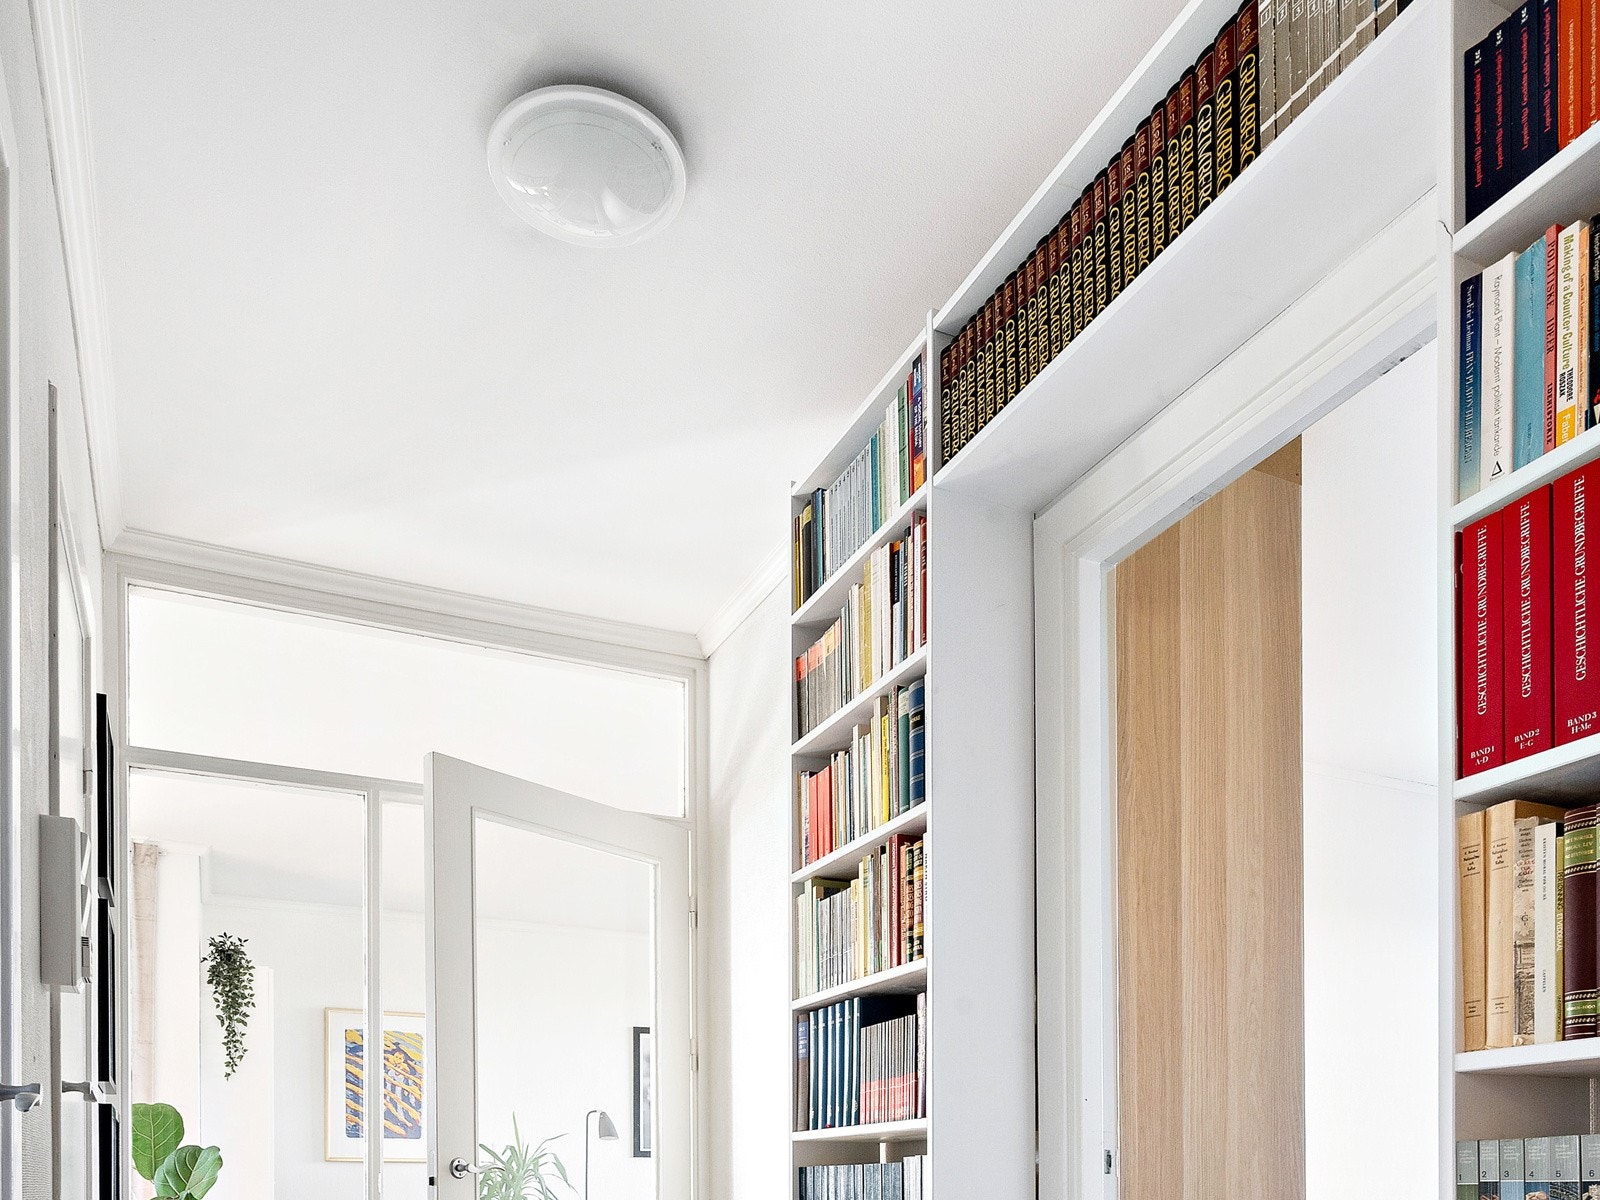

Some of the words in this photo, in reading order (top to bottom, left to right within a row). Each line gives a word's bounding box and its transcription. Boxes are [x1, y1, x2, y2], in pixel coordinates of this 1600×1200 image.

[1561, 234, 1574, 274] Making
[1492, 274, 1502, 316] Raymond
[1547, 240, 1555, 310] POLITISKE
[1563, 274, 1573, 283] of
[1494, 316, 1503, 337] Plant
[1563, 292, 1573, 332] Counter
[1546, 317, 1555, 354] IDEER
[1562, 333, 1573, 370] Culture
[1494, 346, 1502, 383] Modernt
[1492, 384, 1501, 416] politiskt
[1574, 476, 1586, 576] GRUNDBEGRIFFE
[1520, 502, 1530, 597] GRUNDBEGRIFFE
[1478, 525, 1487, 618] GRUNDBEGRIFFE
[1522, 598, 1531, 697] GESCHICHTLICHE
[1575, 576, 1586, 680] GESCHICHTLICHE
[1478, 618, 1487, 715] GESCHICHTLICHE
